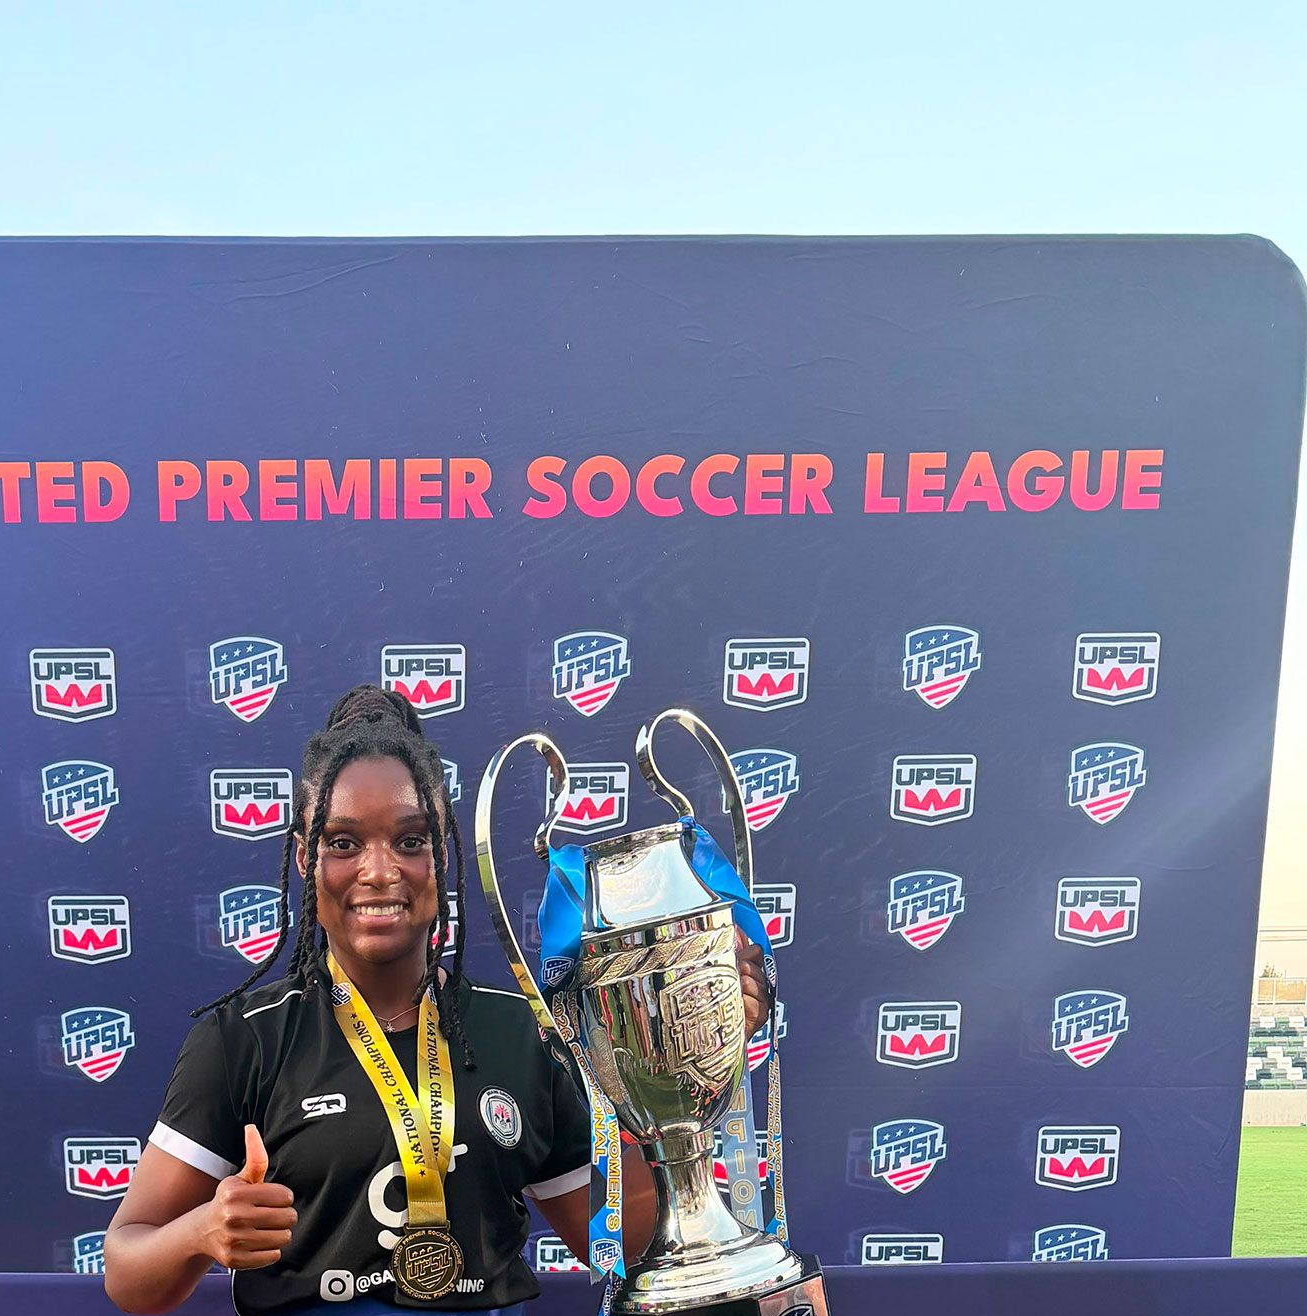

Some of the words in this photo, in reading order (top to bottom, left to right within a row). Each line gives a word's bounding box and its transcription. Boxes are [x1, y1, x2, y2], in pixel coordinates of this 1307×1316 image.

[158, 458, 493, 522] PREMIER
[522, 453, 833, 518] SOCCER
[864, 450, 1164, 513] LEAGUE
[385, 658, 461, 677] UPSL
[728, 652, 805, 669] UPSL
[905, 641, 979, 688] UPSL
[1079, 646, 1155, 664] UPSL
[34, 662, 111, 680] UPSL
[212, 652, 285, 701] UPSL
[555, 648, 628, 695] UPSL
[214, 782, 289, 800] UPSL
[896, 768, 971, 785] UPSL
[1071, 758, 1144, 802] UPSL
[45, 776, 116, 821] UPSL
[754, 896, 791, 913] SL
[890, 885, 962, 931] UPSL
[1061, 890, 1136, 907] UPSL
[52, 909, 126, 925] UPSL
[882, 1014, 956, 1031] UPSL
[1054, 1004, 1126, 1048] UPSL
[65, 1021, 132, 1063] UPSL
[353, 1020, 397, 1087] CHAMPIONS
[426, 1019, 441, 1079] NATIONAL
[392, 1088, 426, 1165] NATIONAL
[591, 1087, 608, 1165] IONAL
[68, 1149, 138, 1164] UPSL
[874, 1132, 943, 1175] UPSL
[1041, 1138, 1115, 1154] UPSL
[607, 1120, 622, 1232] WOMEN'S
[406, 1250, 451, 1280] UPSL
[540, 1249, 576, 1264] UP
[594, 1246, 618, 1263] UPSL
[866, 1246, 938, 1261] UPSL
